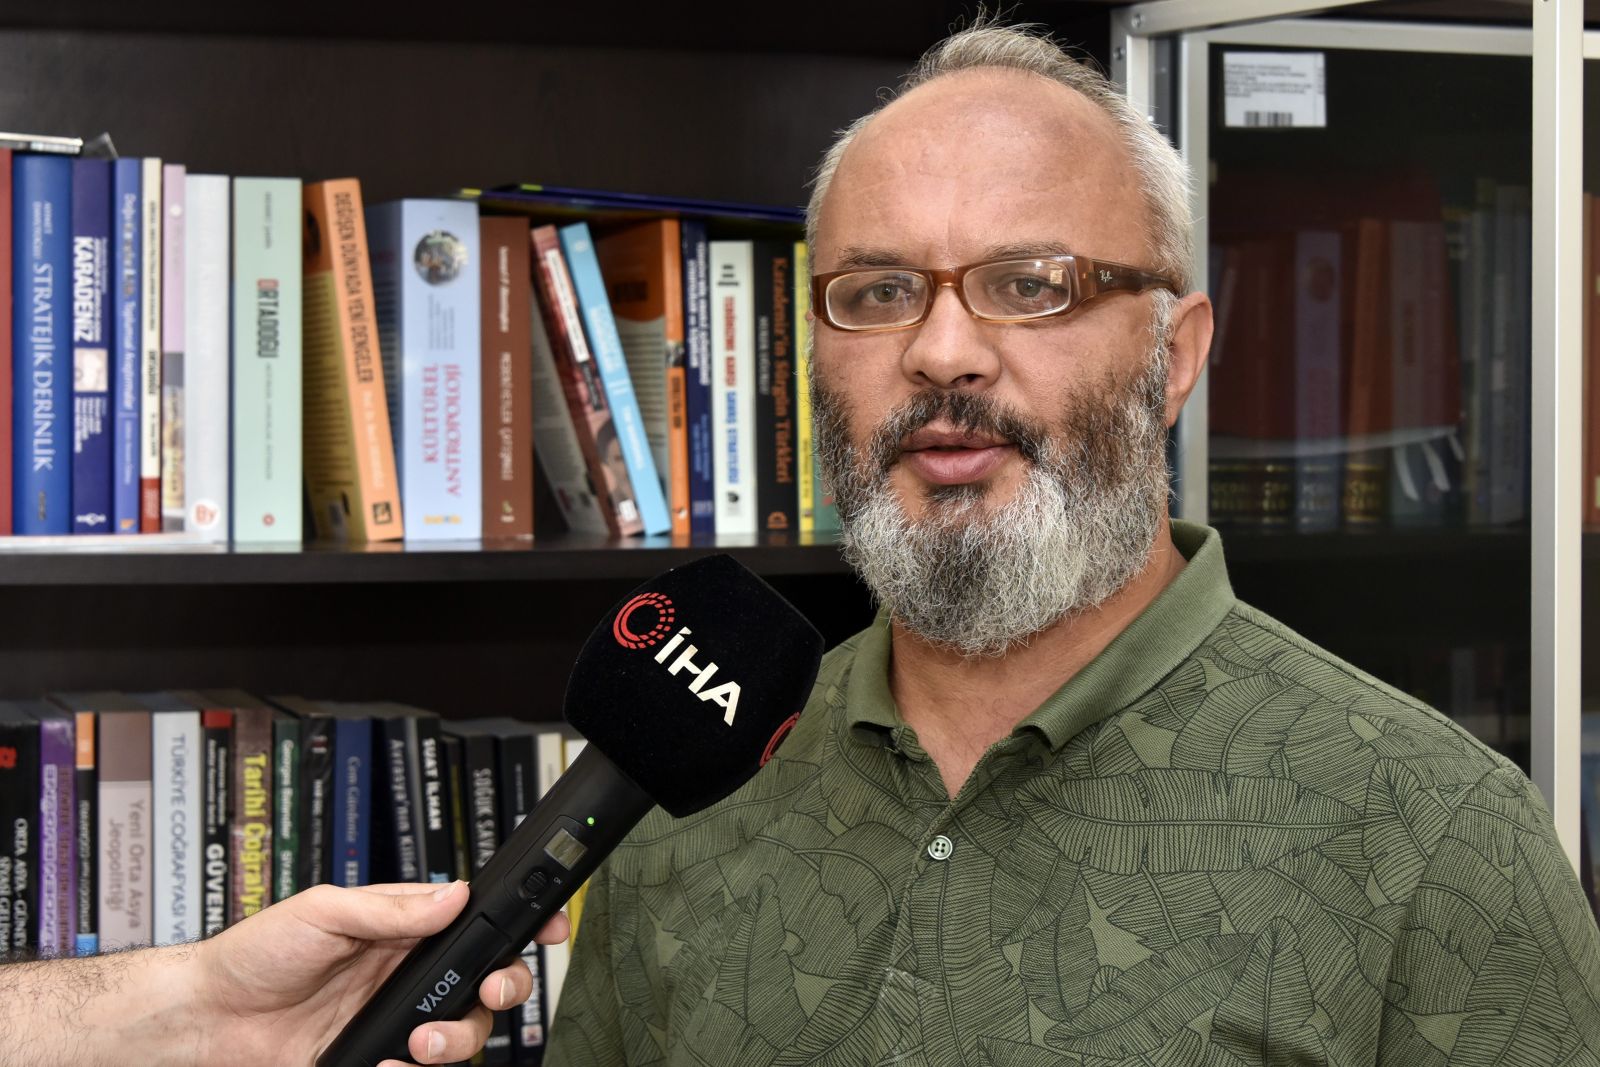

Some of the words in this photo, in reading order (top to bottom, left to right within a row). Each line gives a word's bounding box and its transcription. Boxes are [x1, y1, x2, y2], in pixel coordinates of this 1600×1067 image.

[333, 191, 356, 243] DEĞİŞEN
[340, 243, 362, 296] DÜNYADA
[30, 262, 56, 366] STRATEJİK
[348, 296, 368, 324] YENİ
[772, 257, 791, 358] Karadeniz'in
[351, 322, 374, 384] DENGELER
[419, 364, 440, 464] KÜLTÜREL
[770, 360, 790, 418] Sürgün
[32, 370, 56, 472] DERİNLİK
[443, 364, 464, 498] ANTROPOLOJİ
[775, 419, 793, 484] Türkleri
[654, 626, 741, 727] İHA
[170, 734, 190, 806] TÜRKİYE
[242, 753, 268, 818] Tarihi
[390, 738, 411, 833] Avrasya'nın
[422, 738, 439, 779] SUAT
[128, 799, 146, 839] Yeni
[425, 781, 442, 830] İLHAN
[472, 768, 496, 818] SOĞUK
[13, 817, 28, 856] ORTA
[104, 818, 126, 912] Jeopolitiği
[128, 843, 146, 883] Orta
[170, 809, 190, 917] COĞRAFYASI
[125, 887, 144, 929] Asya
[416, 969, 461, 1013] BOYA
